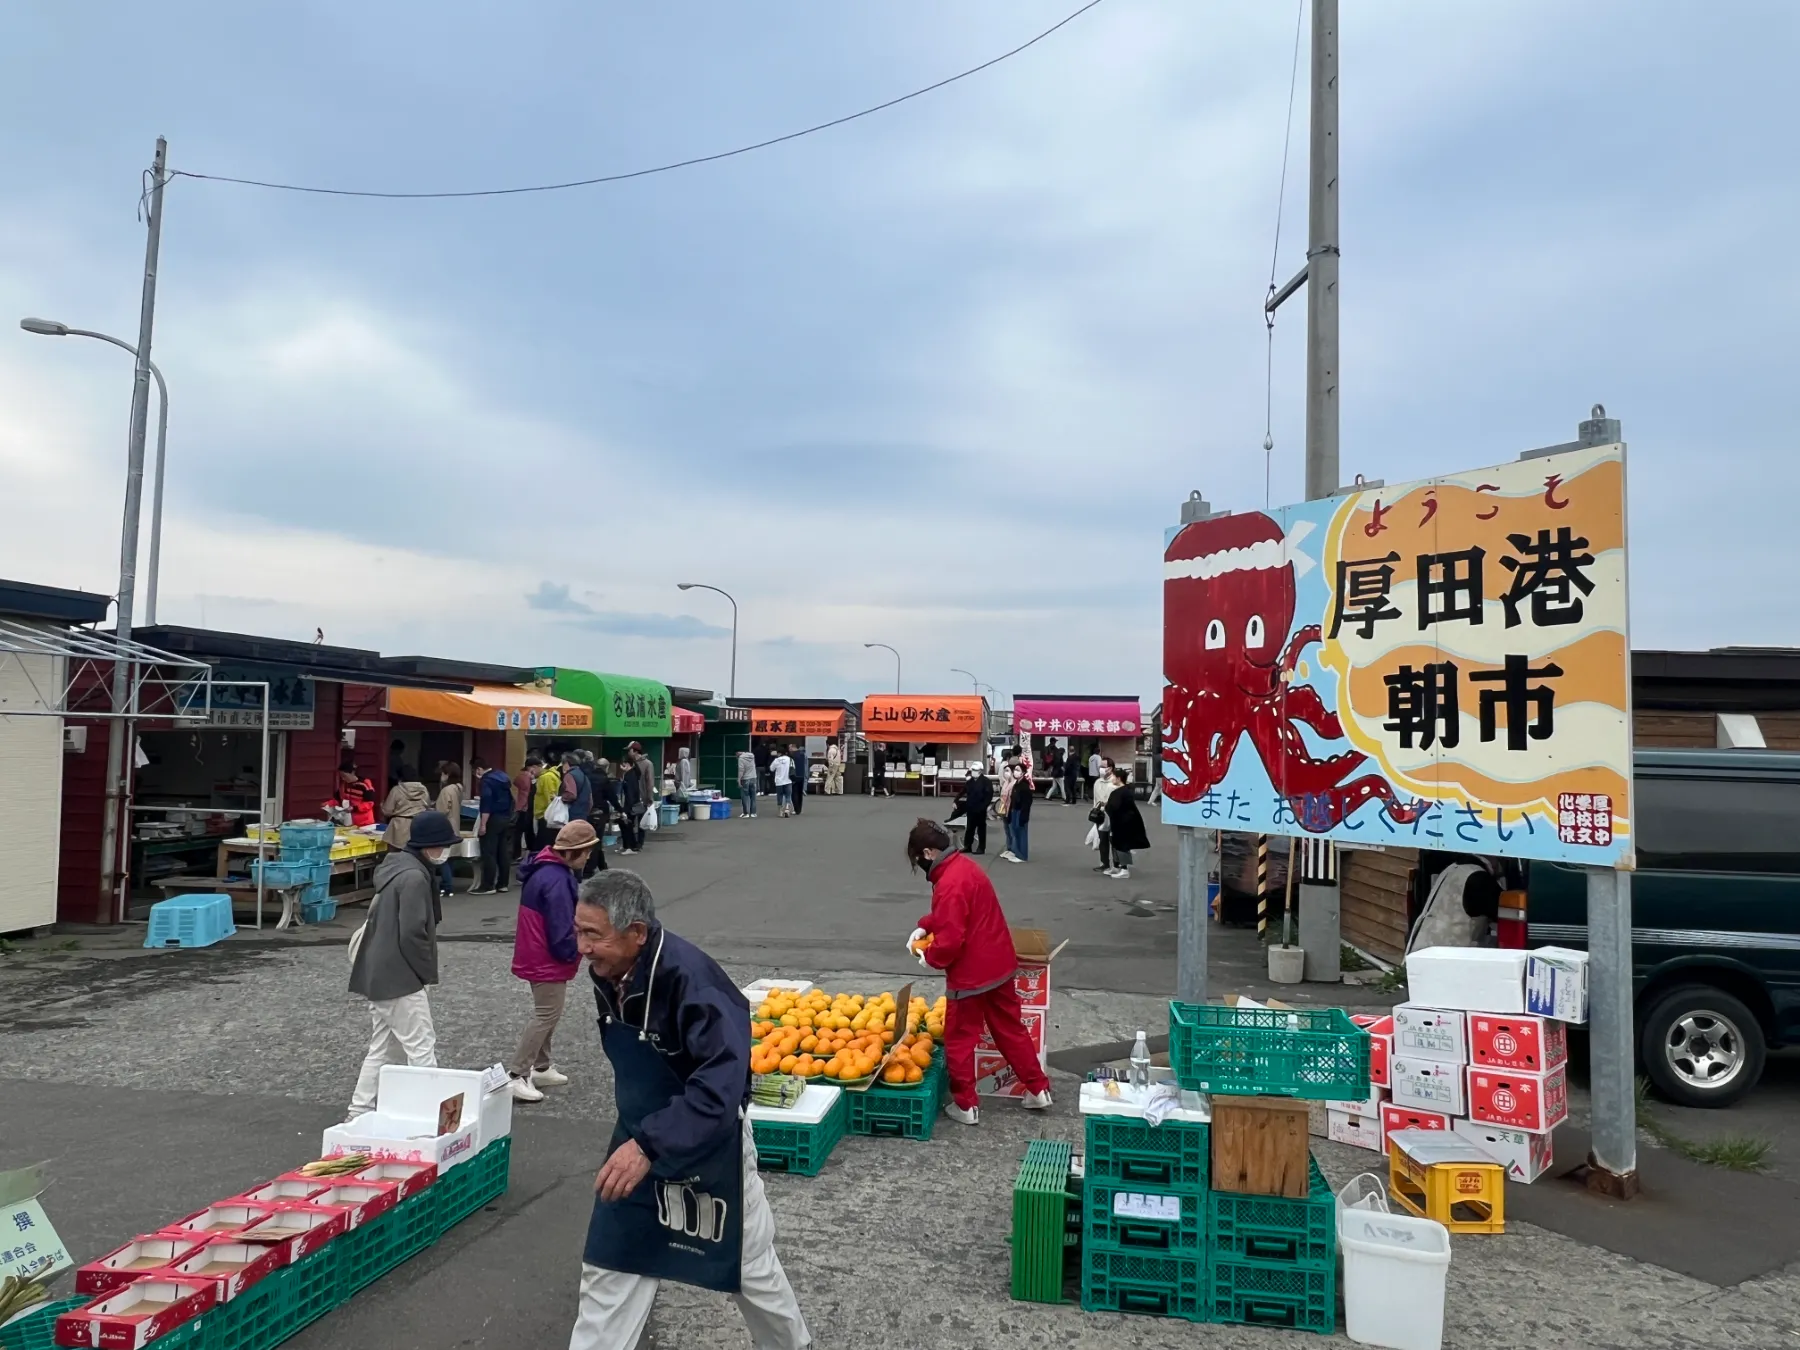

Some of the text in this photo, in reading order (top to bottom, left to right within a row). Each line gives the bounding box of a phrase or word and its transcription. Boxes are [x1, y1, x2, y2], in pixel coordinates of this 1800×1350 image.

[1364, 473, 1569, 538] ようこそ
[1328, 526, 1596, 640] 厚田港
[1382, 654, 1565, 751] 朝市
[1200, 789, 1535, 844] また お越しください
[0, 1242, 37, 1265] 連合会
